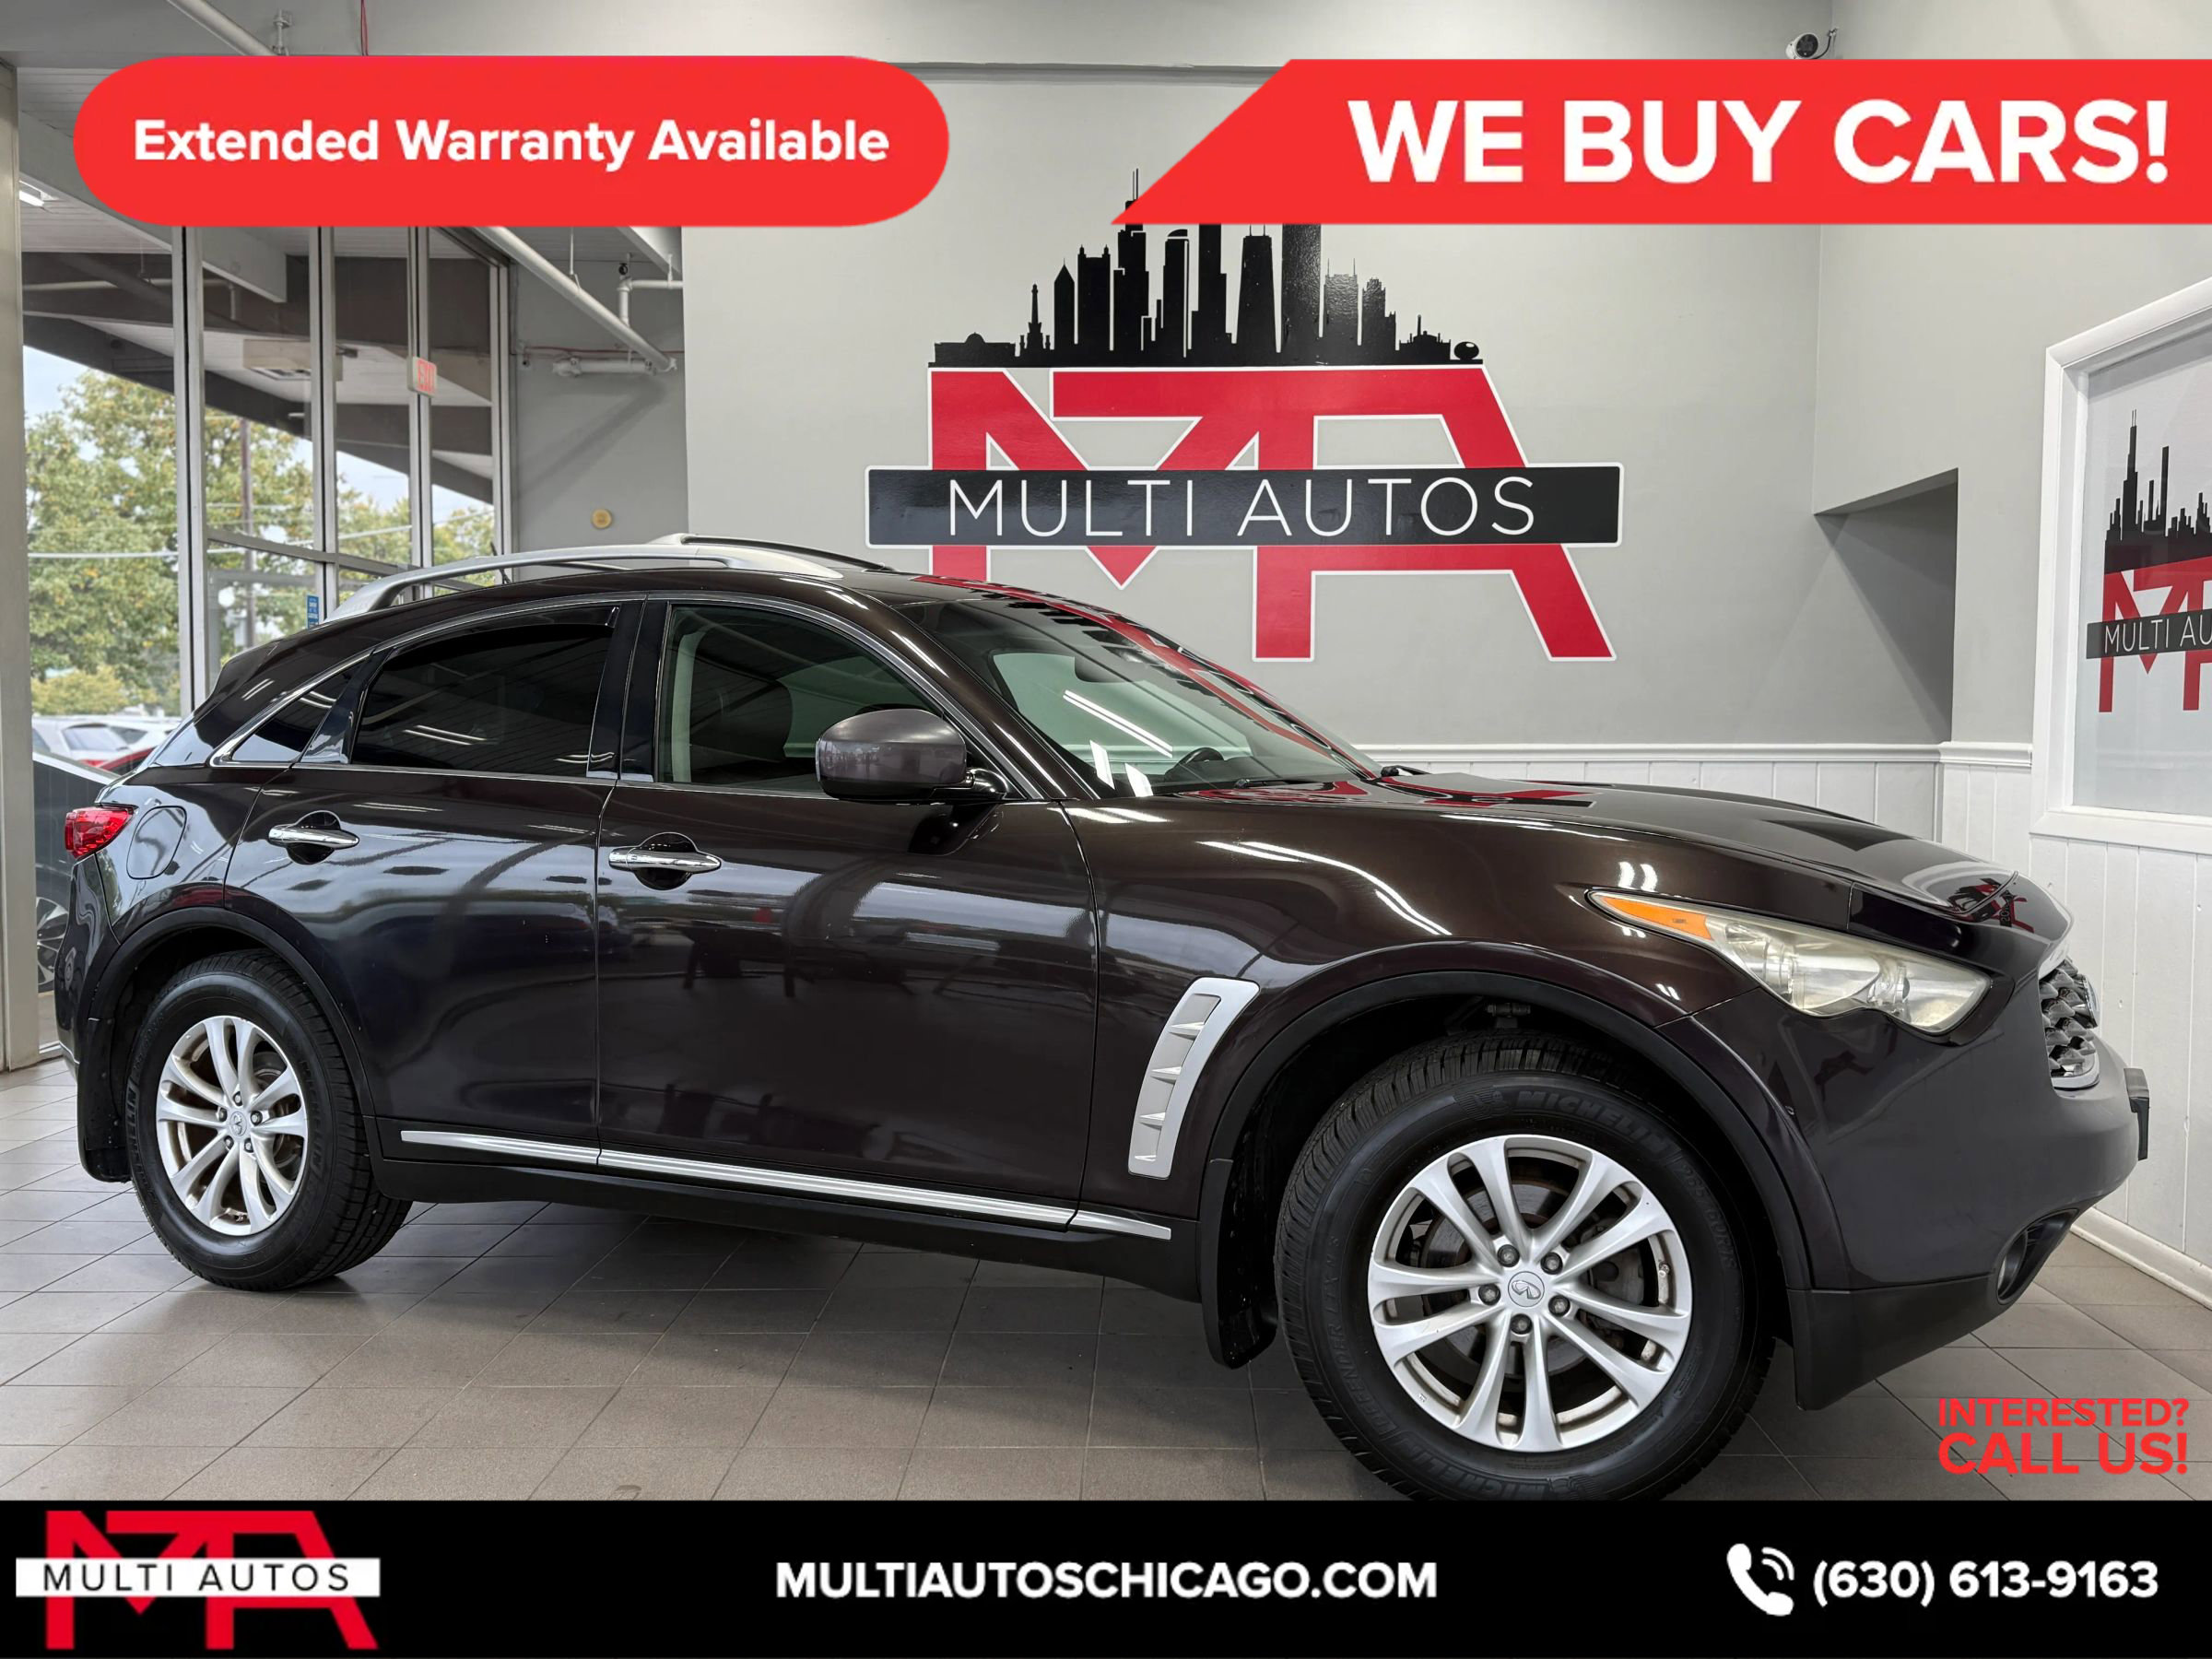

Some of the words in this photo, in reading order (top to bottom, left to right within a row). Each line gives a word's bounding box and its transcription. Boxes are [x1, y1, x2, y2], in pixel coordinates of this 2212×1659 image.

[948, 478, 1194, 537] MULTI
[1237, 476, 1535, 537] AUTOS
[2104, 617, 2170, 653] MULTI
[1517, 1089, 1669, 1156] MICHELIN
